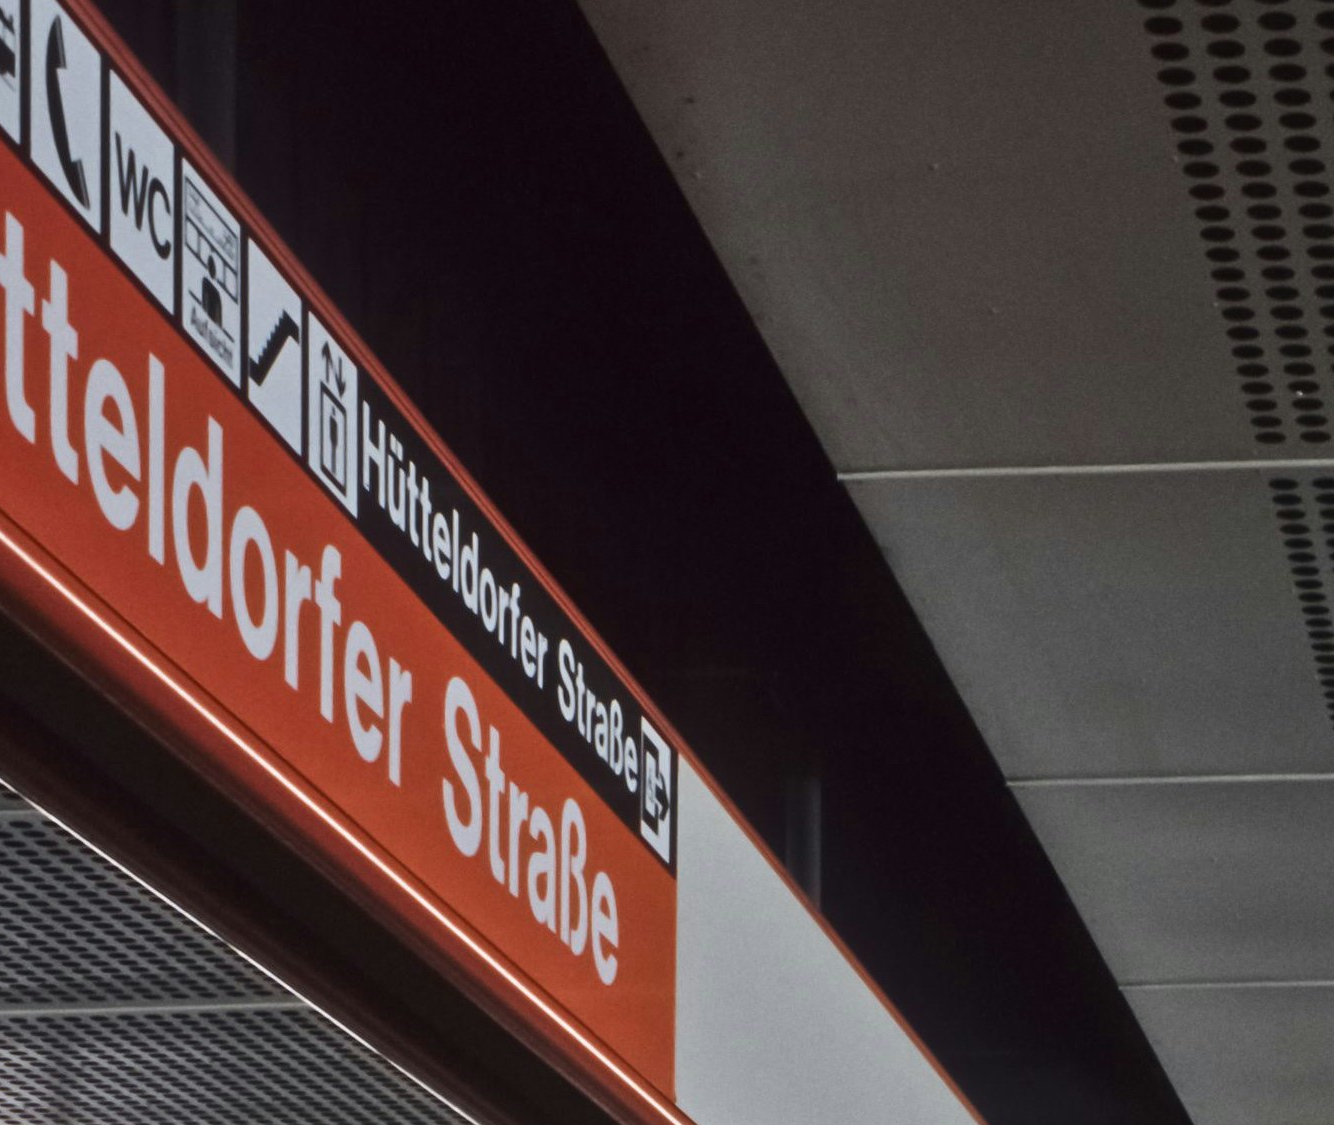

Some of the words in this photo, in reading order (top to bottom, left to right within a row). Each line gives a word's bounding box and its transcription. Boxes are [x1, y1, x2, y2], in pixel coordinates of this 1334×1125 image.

[114, 130, 172, 261] WC
[361, 400, 549, 690] Hütteldorfer
[557, 638, 638, 793] Straße
[442, 676, 620, 986] Straße
